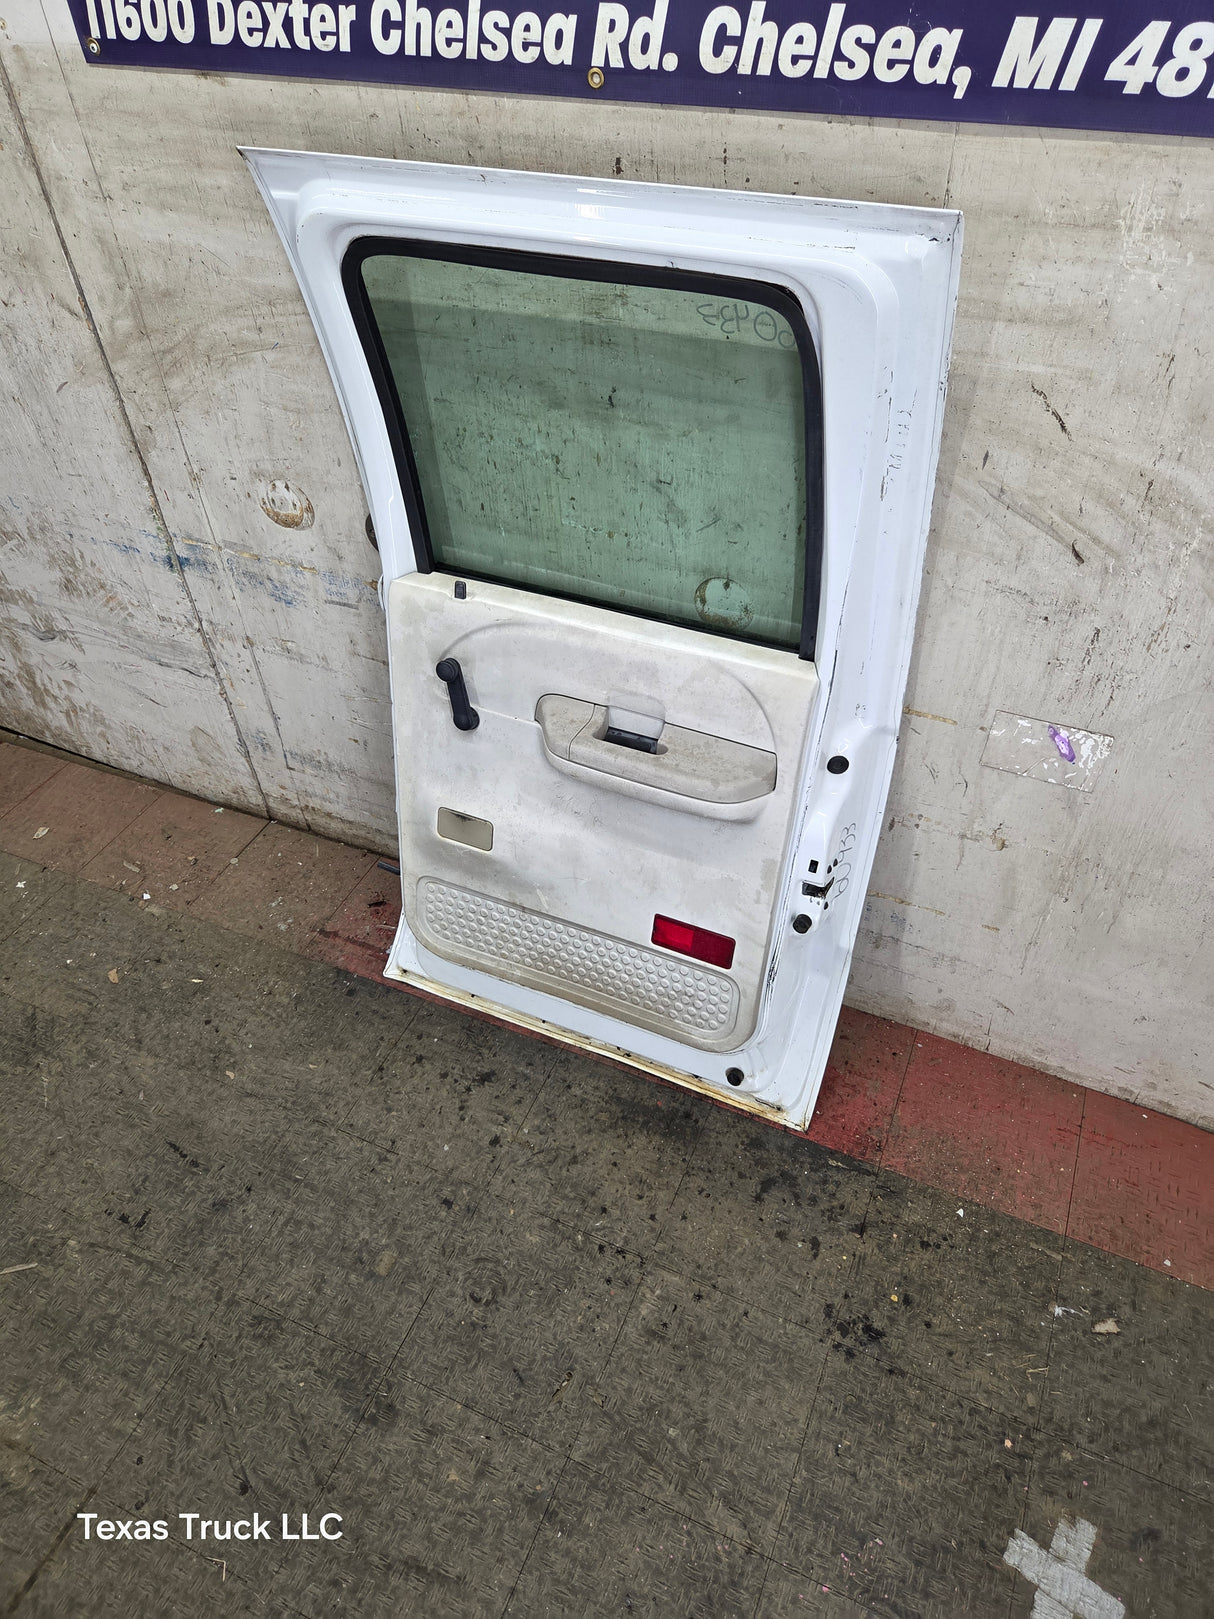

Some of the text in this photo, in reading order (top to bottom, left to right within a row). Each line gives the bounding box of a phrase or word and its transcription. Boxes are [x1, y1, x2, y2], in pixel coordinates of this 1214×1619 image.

[86, 0, 1214, 99] 11600 Dexter Chelsea Rd. Chelsea, MI 48
